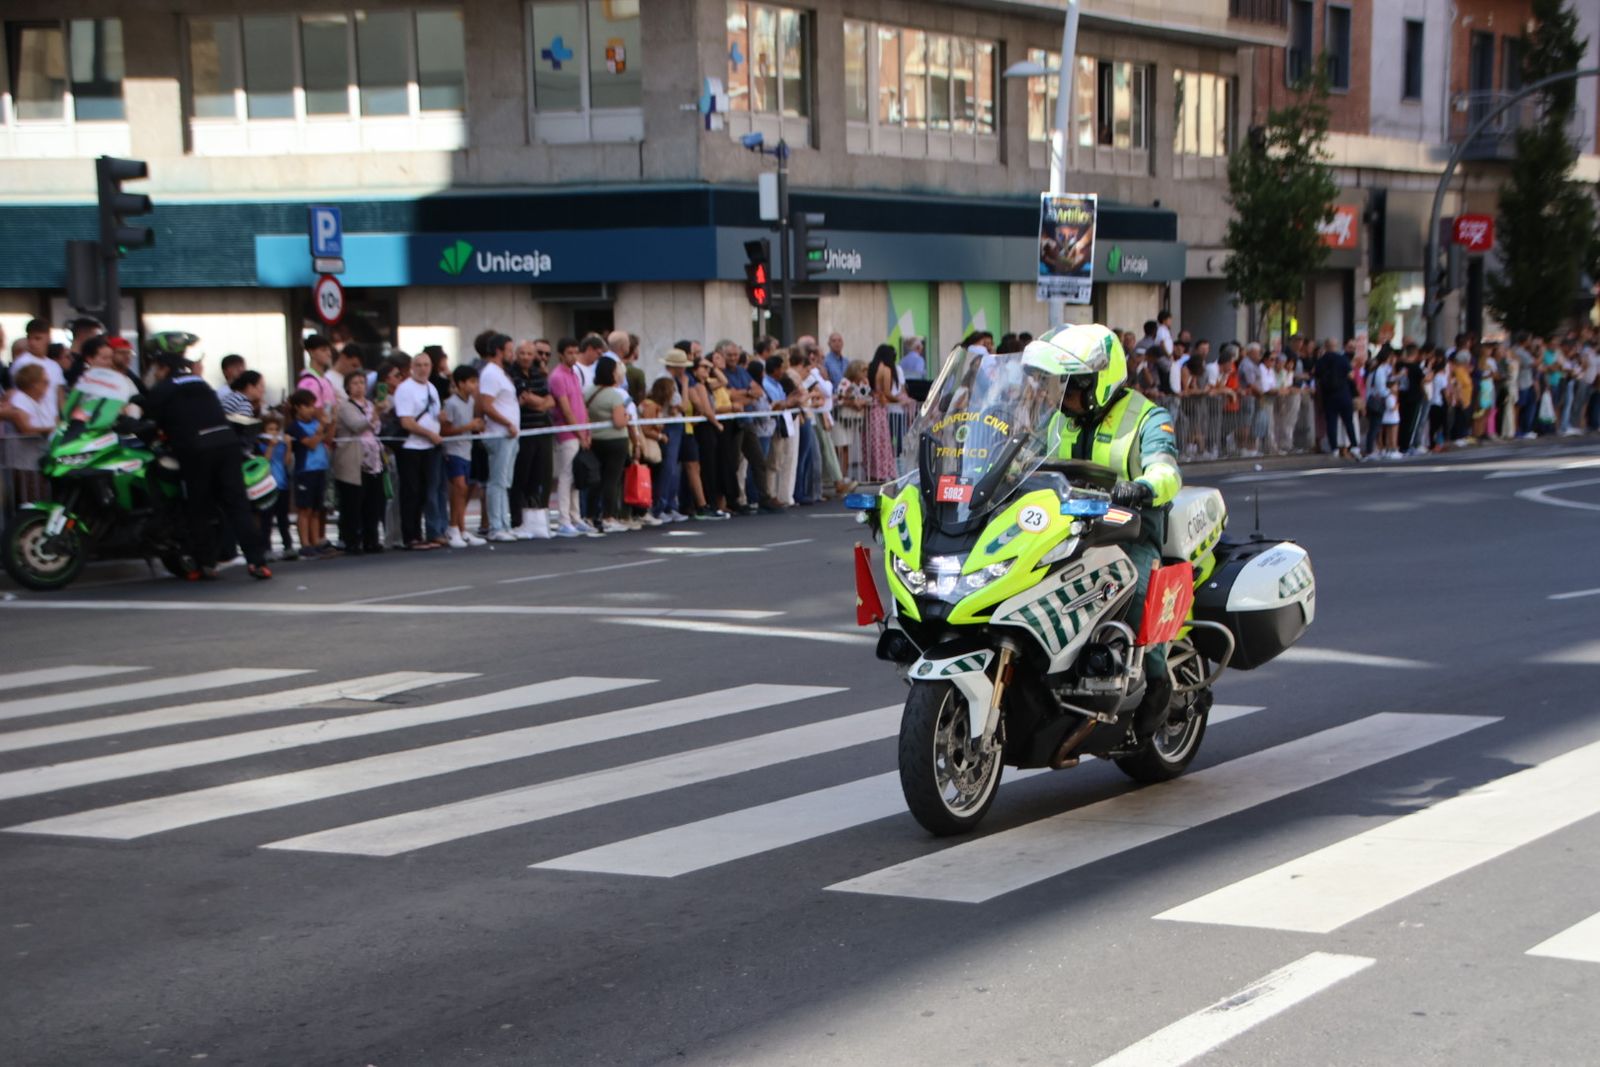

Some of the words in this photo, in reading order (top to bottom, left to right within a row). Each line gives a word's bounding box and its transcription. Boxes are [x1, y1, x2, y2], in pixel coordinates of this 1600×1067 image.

[316, 210, 336, 252] P
[476, 249, 552, 278] Unicaja
[824, 248, 862, 275] Unicaja
[932, 411, 981, 433] GUARDIA
[983, 415, 1010, 436] CIVIL
[1024, 510, 1042, 526] 23
